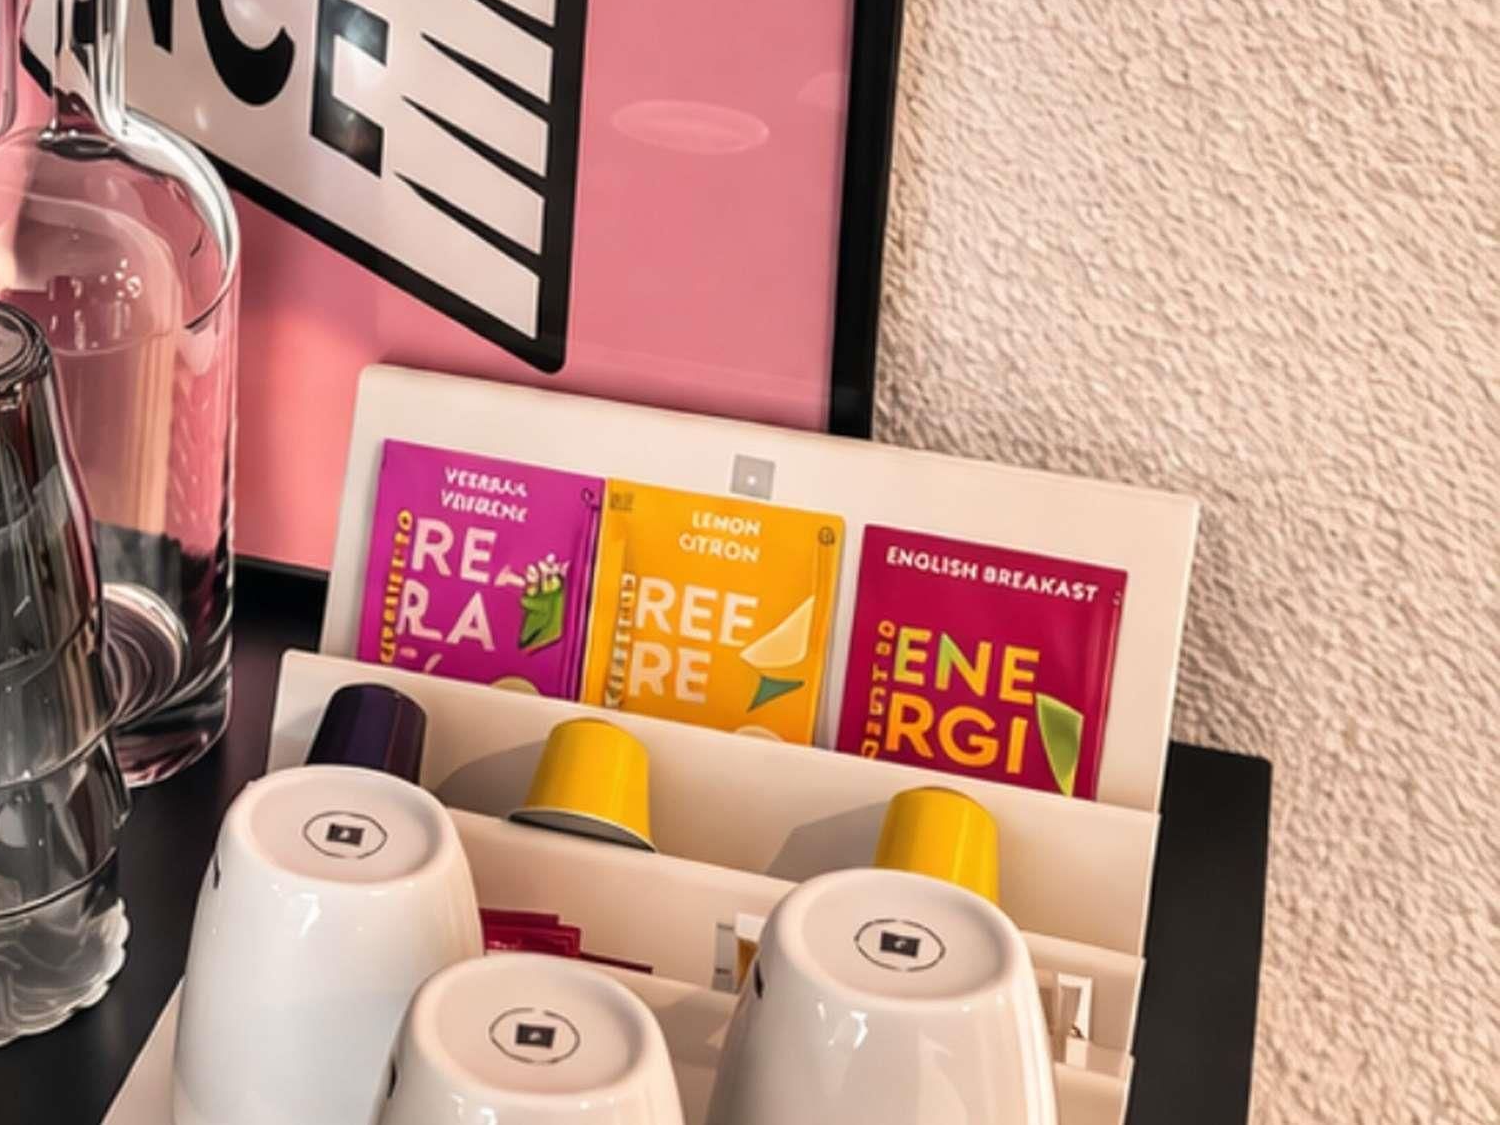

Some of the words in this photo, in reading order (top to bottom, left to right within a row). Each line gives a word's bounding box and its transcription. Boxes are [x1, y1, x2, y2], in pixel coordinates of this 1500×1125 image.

[677, 531, 761, 563] CITRON
[691, 510, 762, 537] LEMON
[886, 545, 979, 580] ENGLISH
[634, 575, 760, 648] REE
[627, 640, 712, 704] RE
[893, 625, 1041, 706] ENE
[884, 690, 1029, 775] RGI
